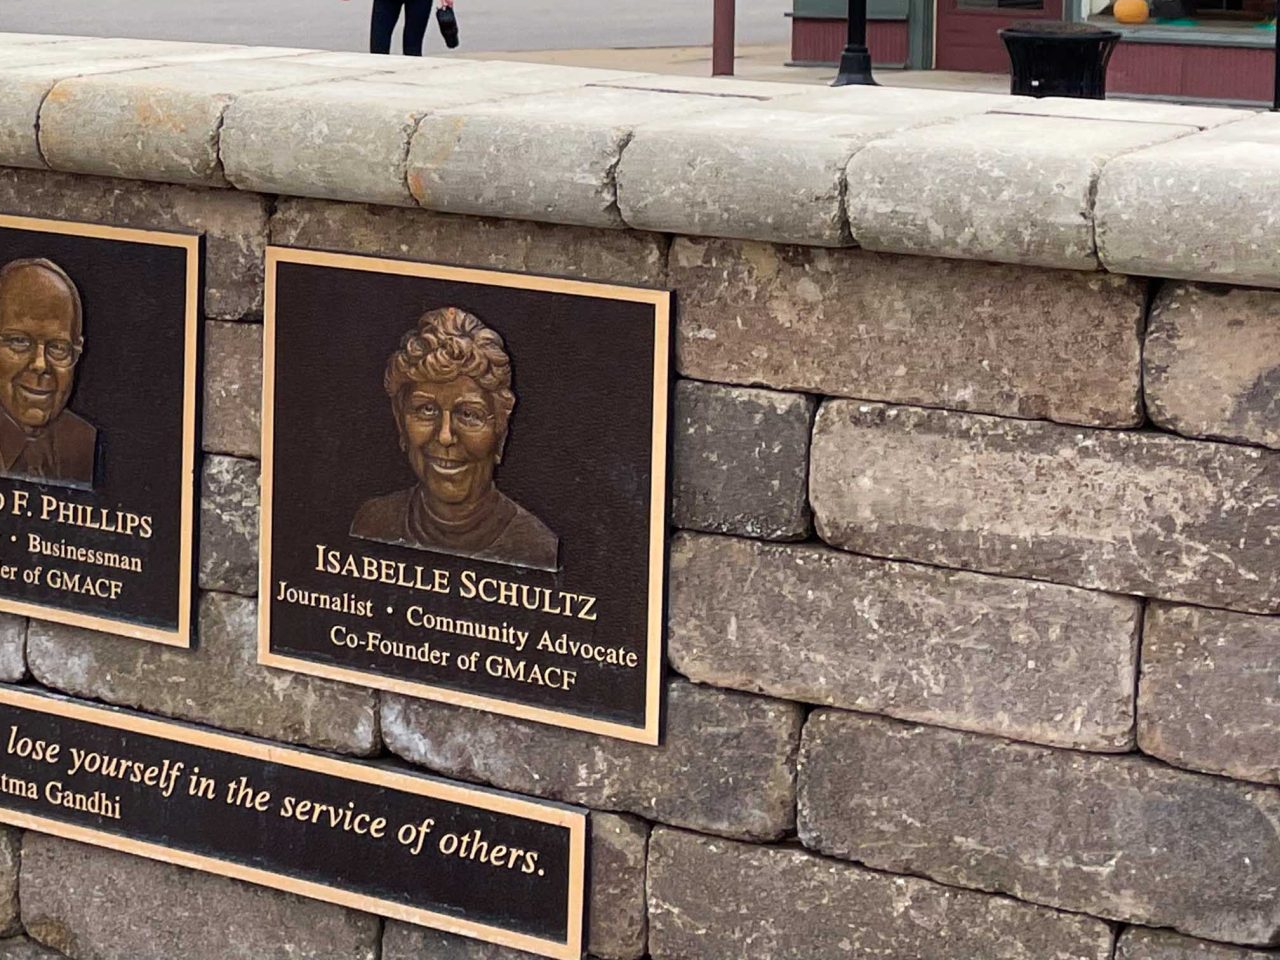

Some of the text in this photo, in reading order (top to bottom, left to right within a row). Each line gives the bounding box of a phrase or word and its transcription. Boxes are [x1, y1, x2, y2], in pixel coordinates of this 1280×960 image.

[11, 490, 32, 517] F.
[40, 495, 153, 538] PHILLIPS
[28, 533, 142, 572] Businessman
[23, 567, 42, 585] of
[46, 569, 123, 599] GMACF
[315, 544, 597, 621] ISABELLE SCHULTZ
[277, 581, 638, 667] Journalist Community Advocate
[330, 625, 577, 691] Co-Founder of GMACF
[7, 725, 61, 763] lose
[67, 748, 184, 797] yourself
[188, 766, 216, 800] in
[226, 777, 271, 811] the
[280, 796, 387, 838] service
[397, 818, 435, 855] of
[439, 830, 545, 876] others.
[45, 781, 121, 820] Gandhi
